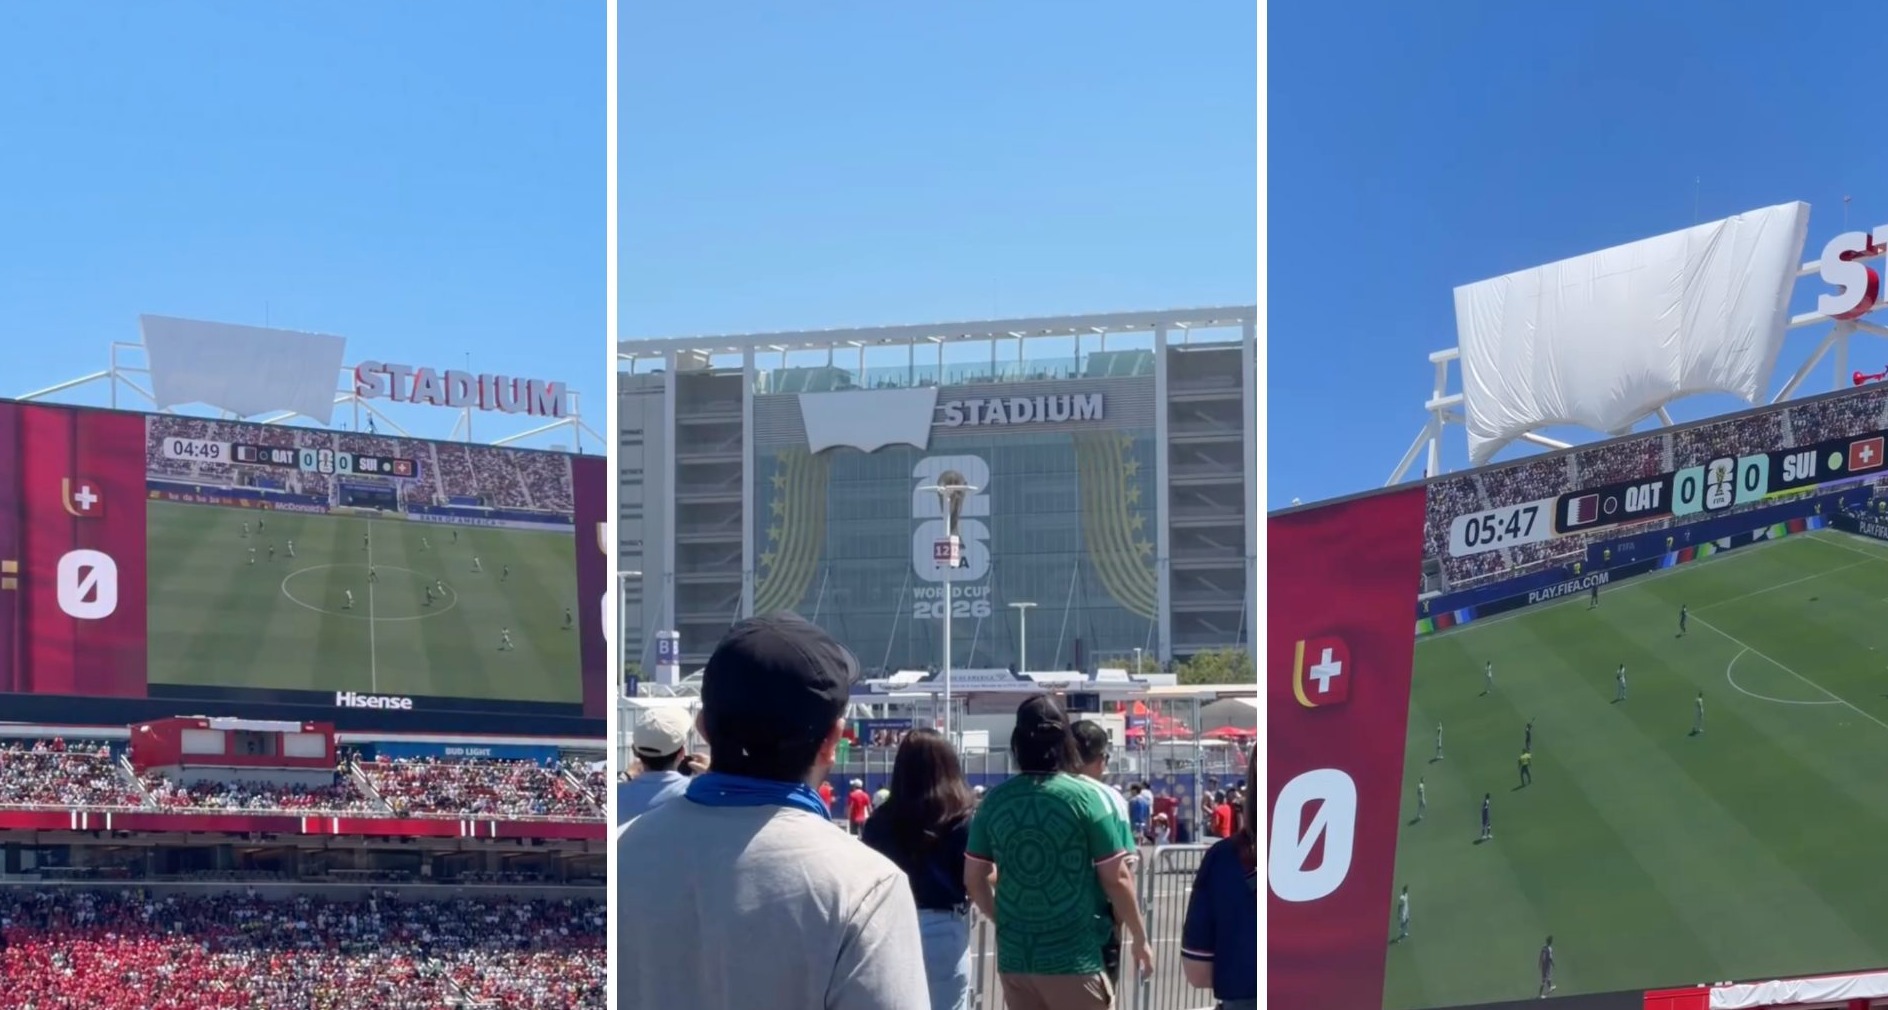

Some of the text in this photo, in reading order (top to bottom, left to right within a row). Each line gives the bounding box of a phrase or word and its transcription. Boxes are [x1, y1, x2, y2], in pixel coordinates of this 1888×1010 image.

[1818, 224, 1888, 320] S
[355, 360, 567, 418] STADIUM
[944, 393, 1103, 427] STADIUM
[173, 440, 220, 458] 04:49
[272, 449, 378, 472] QAT 0 0 SUI
[1625, 450, 1817, 513] QAT 0 0 SUI
[1465, 506, 1539, 547] 05:47
[935, 545, 950, 556] 12
[57, 548, 118, 620] 0
[913, 586, 991, 599] WORD CUP
[1528, 572, 1609, 604] PLAY.FIFA.COM
[660, 640, 669, 654] B
[336, 691, 413, 710] Hisense
[445, 747, 491, 757] BUD LIGHT
[1267, 768, 1358, 903] 0
